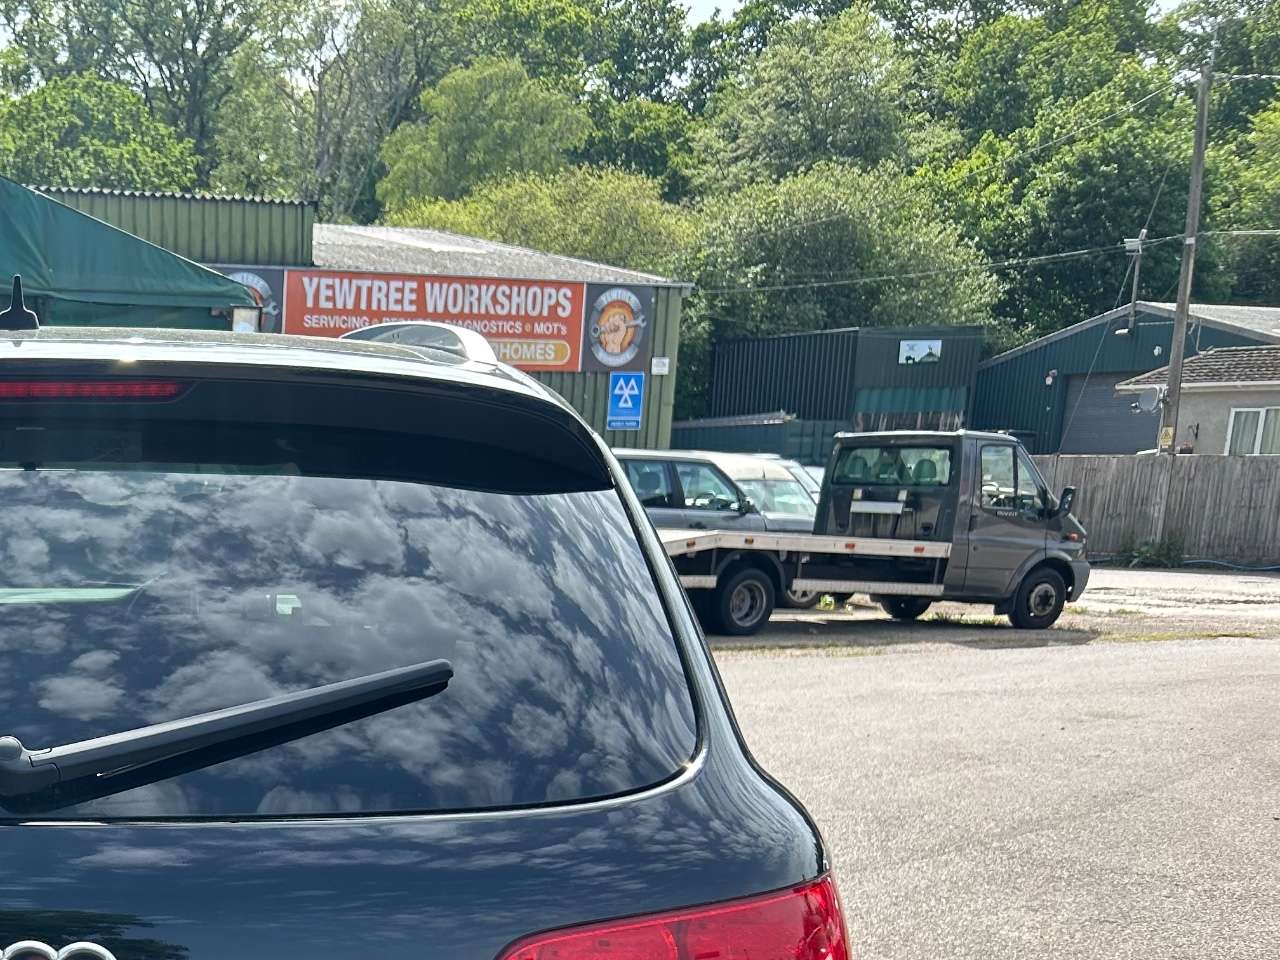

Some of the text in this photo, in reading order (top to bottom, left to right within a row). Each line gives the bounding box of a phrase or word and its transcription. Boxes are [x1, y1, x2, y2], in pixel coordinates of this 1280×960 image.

[301, 275, 418, 313] YEWTREE
[424, 281, 573, 319] WORKSHOPS
[303, 314, 369, 329] SERVICING
